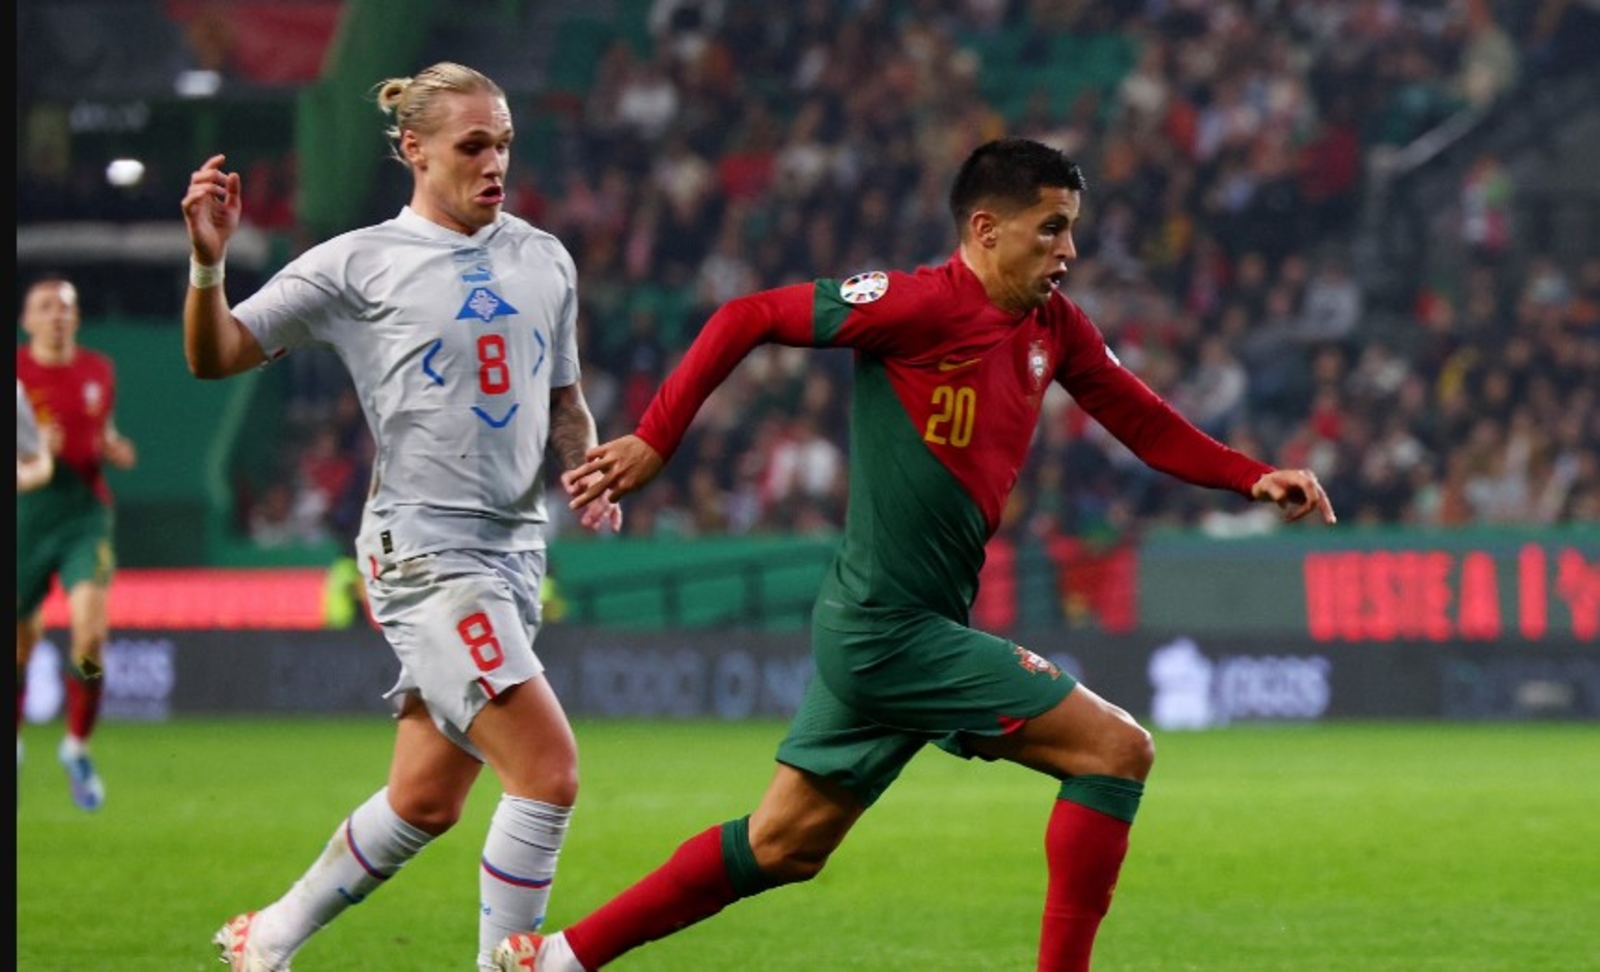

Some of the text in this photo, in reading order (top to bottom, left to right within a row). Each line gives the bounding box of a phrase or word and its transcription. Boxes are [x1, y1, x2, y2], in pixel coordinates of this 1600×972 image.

[476, 334, 510, 395] 8
[924, 385, 977, 448] 20
[456, 611, 506, 673] 8
